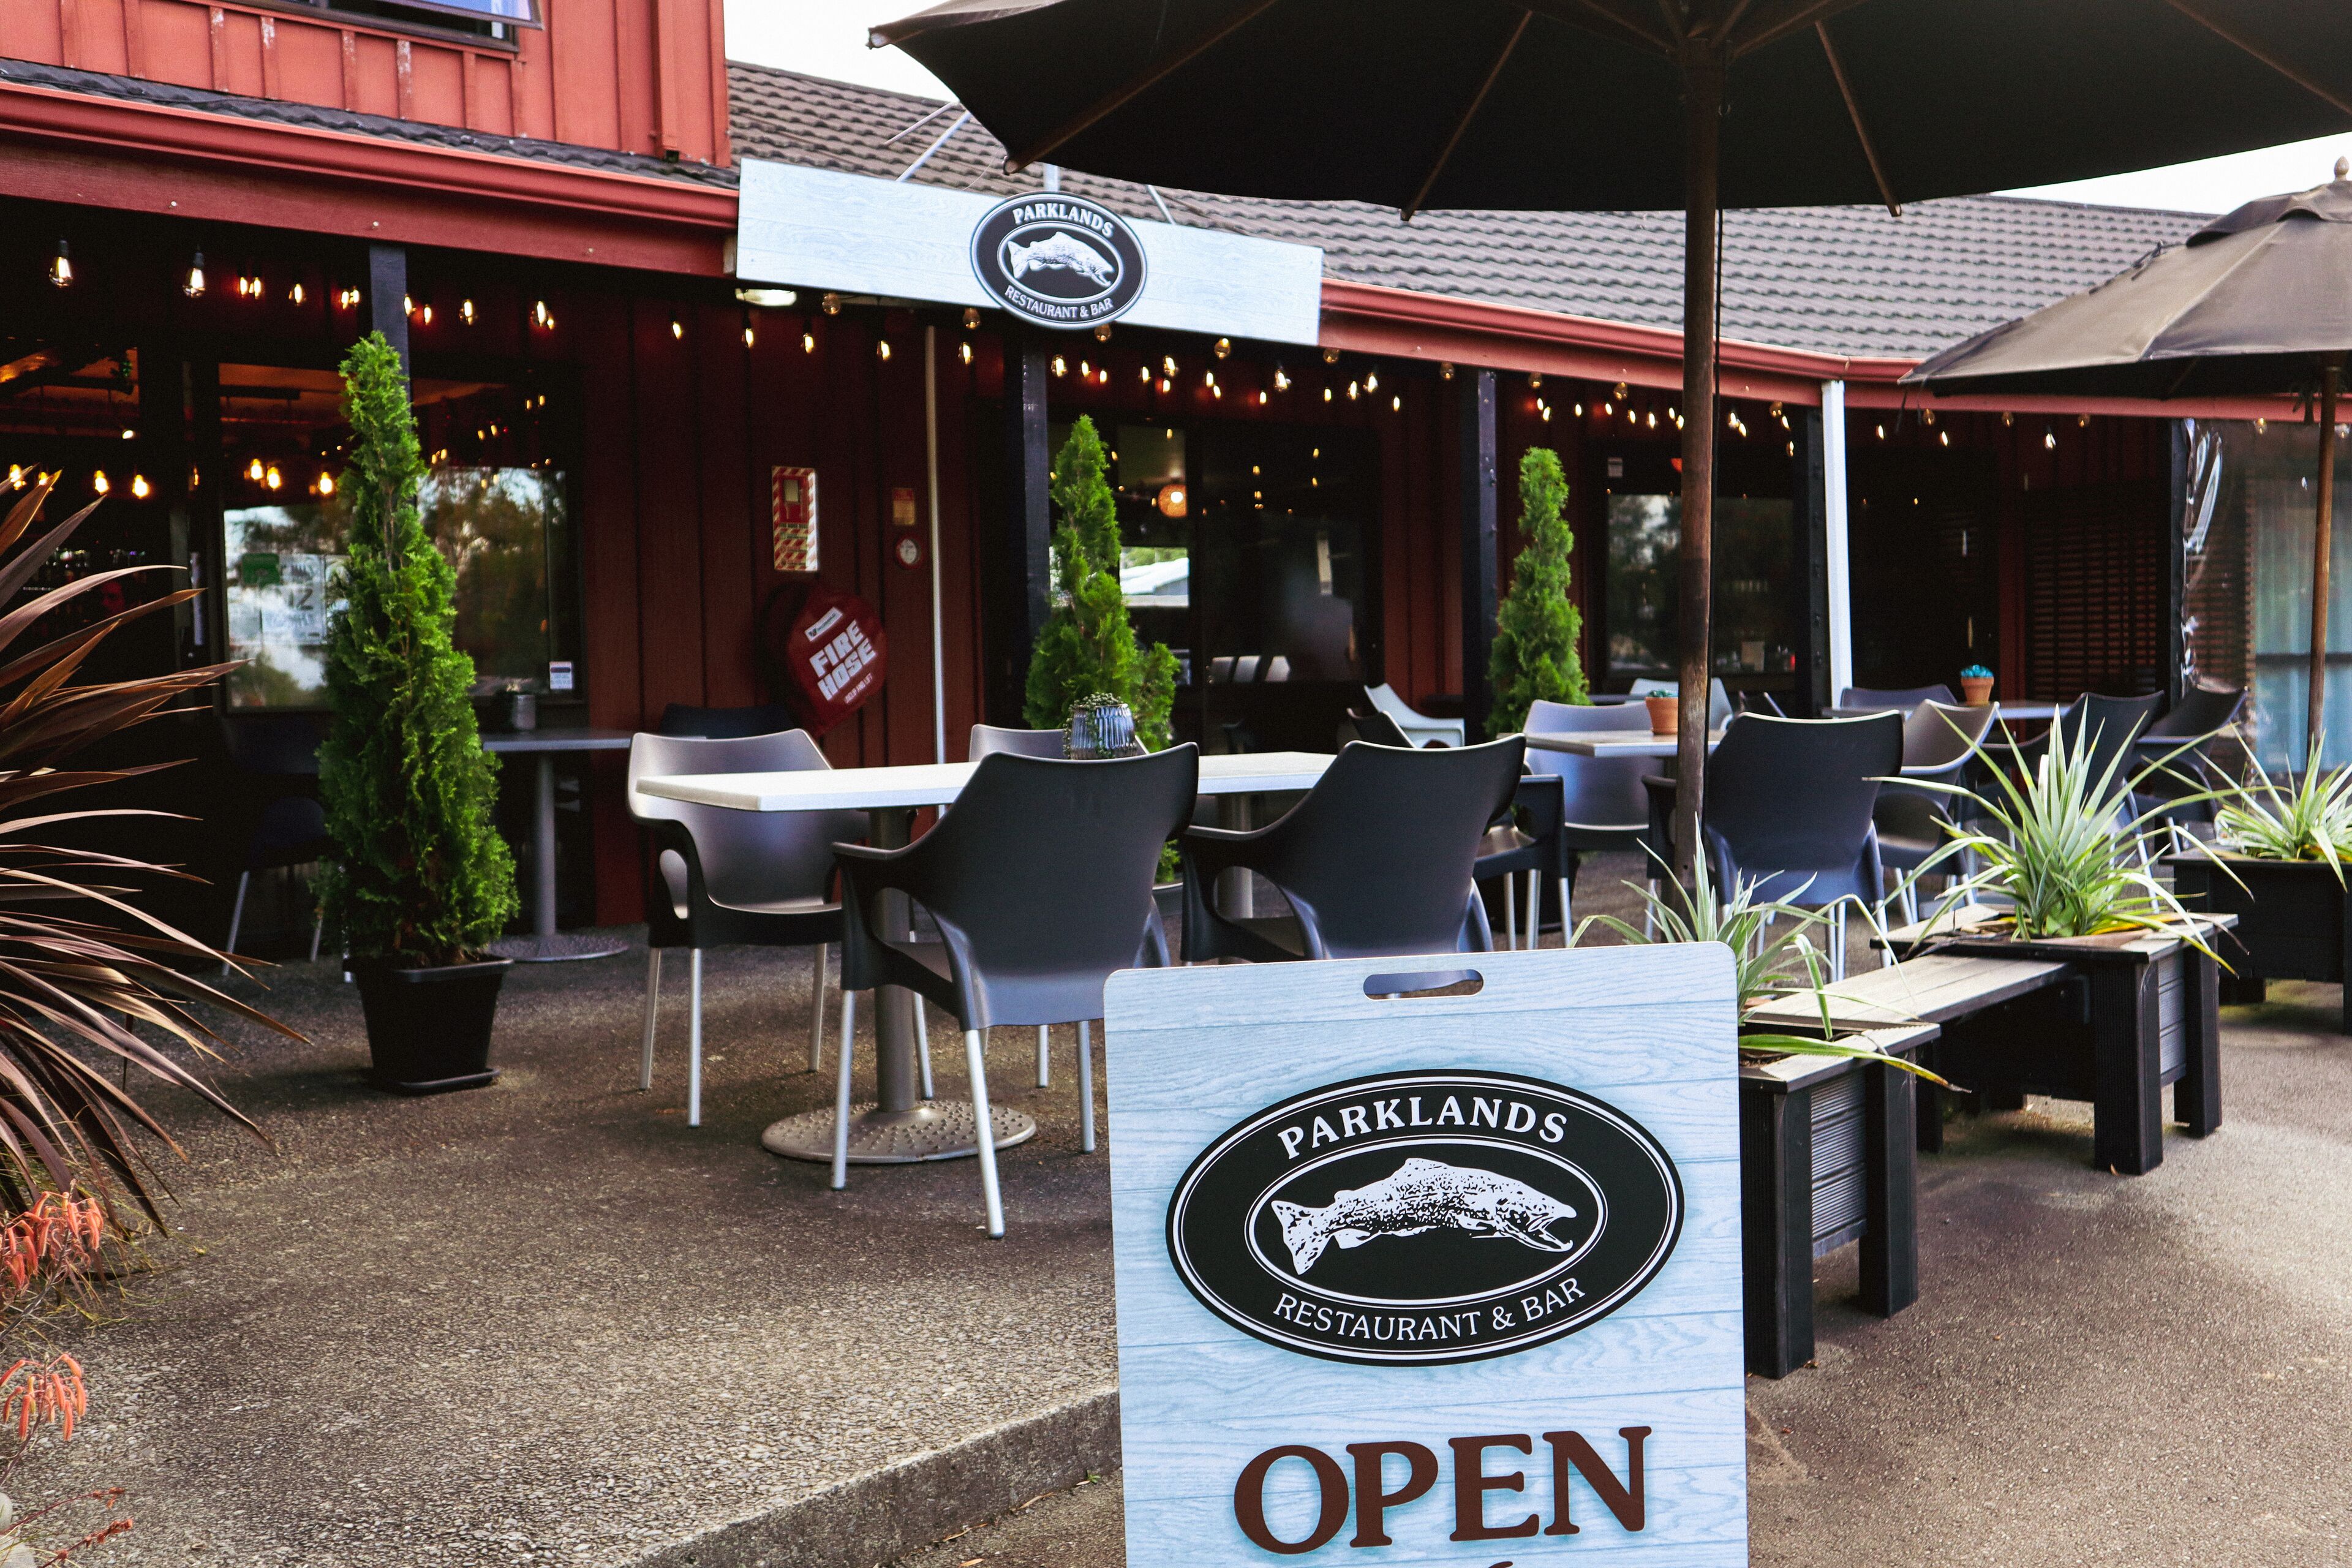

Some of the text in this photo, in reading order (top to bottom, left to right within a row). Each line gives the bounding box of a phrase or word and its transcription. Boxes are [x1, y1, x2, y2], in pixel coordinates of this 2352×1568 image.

[1012, 203, 1115, 238] PARKLANDS
[1005, 285, 1114, 318] RESTAURANT & BAR
[809, 619, 864, 677] FIRE
[817, 638, 876, 701] HOSE
[1277, 1095, 1567, 1160] PARKLANDS
[1273, 1278, 1586, 1341] RESTAURANT & BAR
[1233, 1425, 1652, 1555] OPEN
